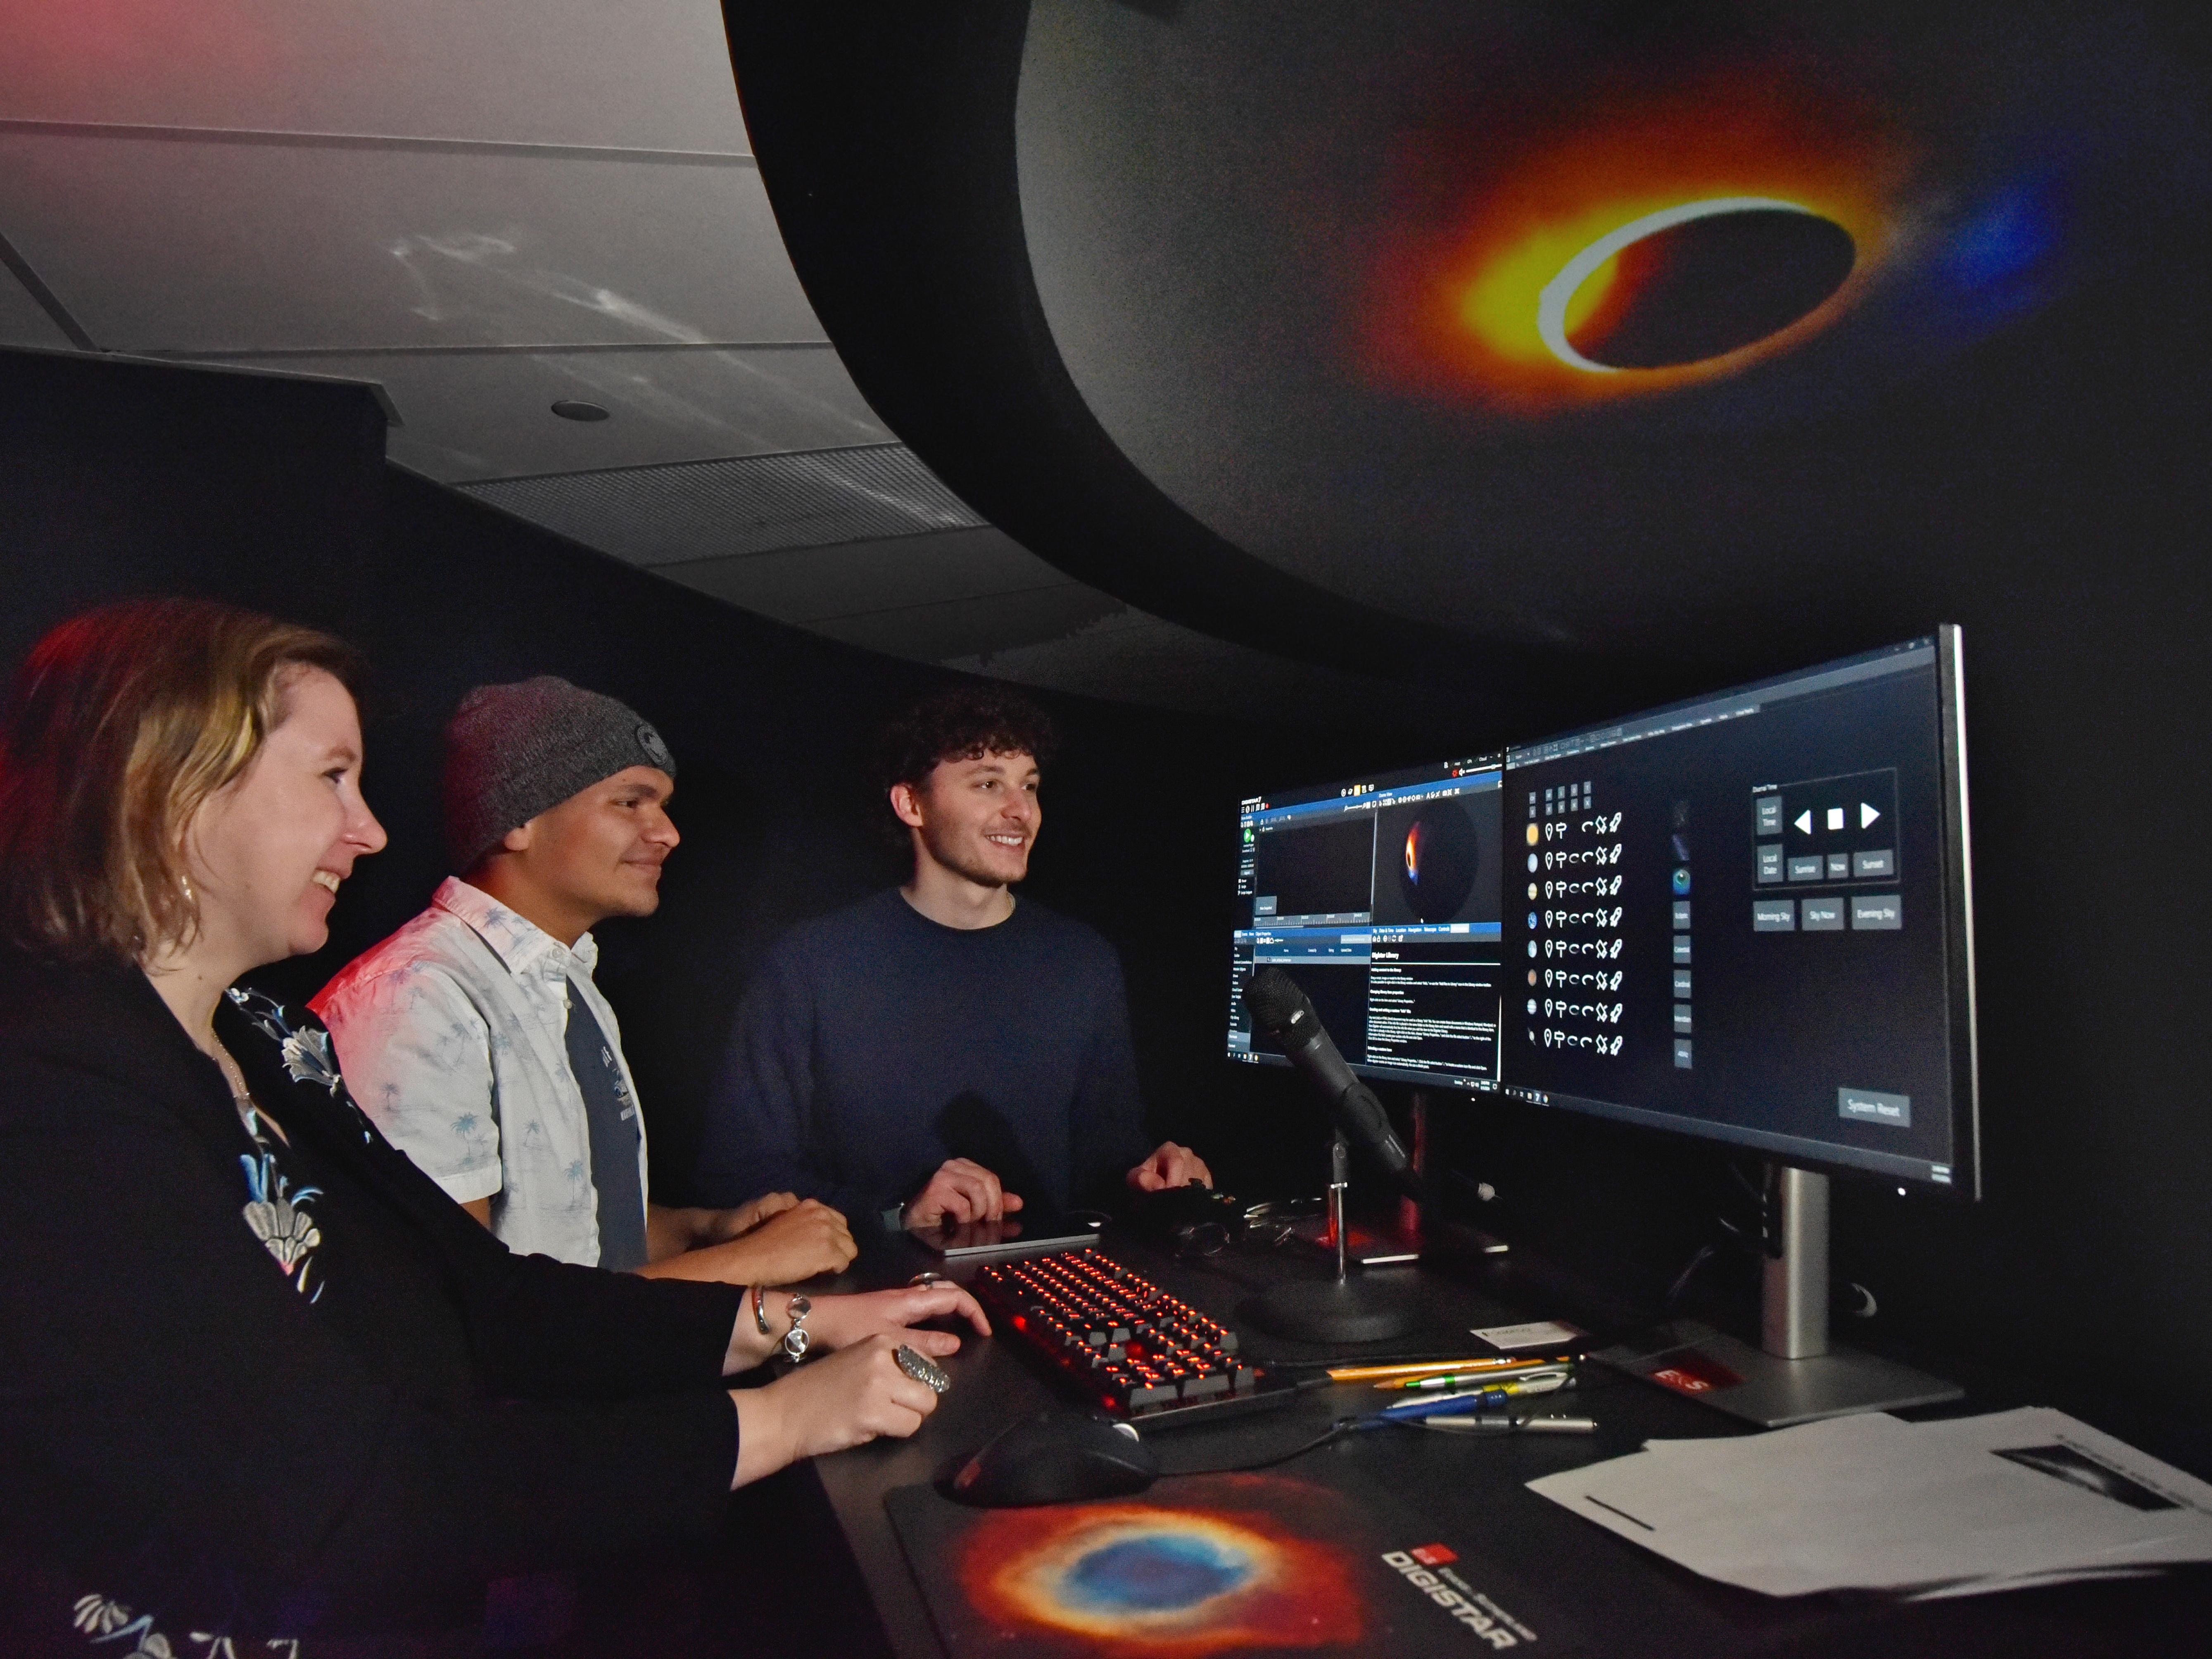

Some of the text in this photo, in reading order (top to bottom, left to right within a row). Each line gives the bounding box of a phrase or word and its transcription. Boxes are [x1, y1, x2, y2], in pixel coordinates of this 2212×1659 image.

[1761, 805, 1776, 815] Local
[1763, 818, 1776, 826] Time
[1763, 854, 1777, 863] Local
[1830, 863, 1845, 871] Now
[1862, 859, 1884, 869] Sunset
[1763, 866, 1777, 875] Date
[1795, 865, 1816, 874] Sunrise
[1757, 912, 1790, 922] Morning Sky
[1810, 911, 1835, 921] Sky Now
[1857, 908, 1895, 920] Evening Sky
[1847, 1098, 1901, 1117] System Reset
[1381, 1550, 1518, 1649] DIGISTAR
